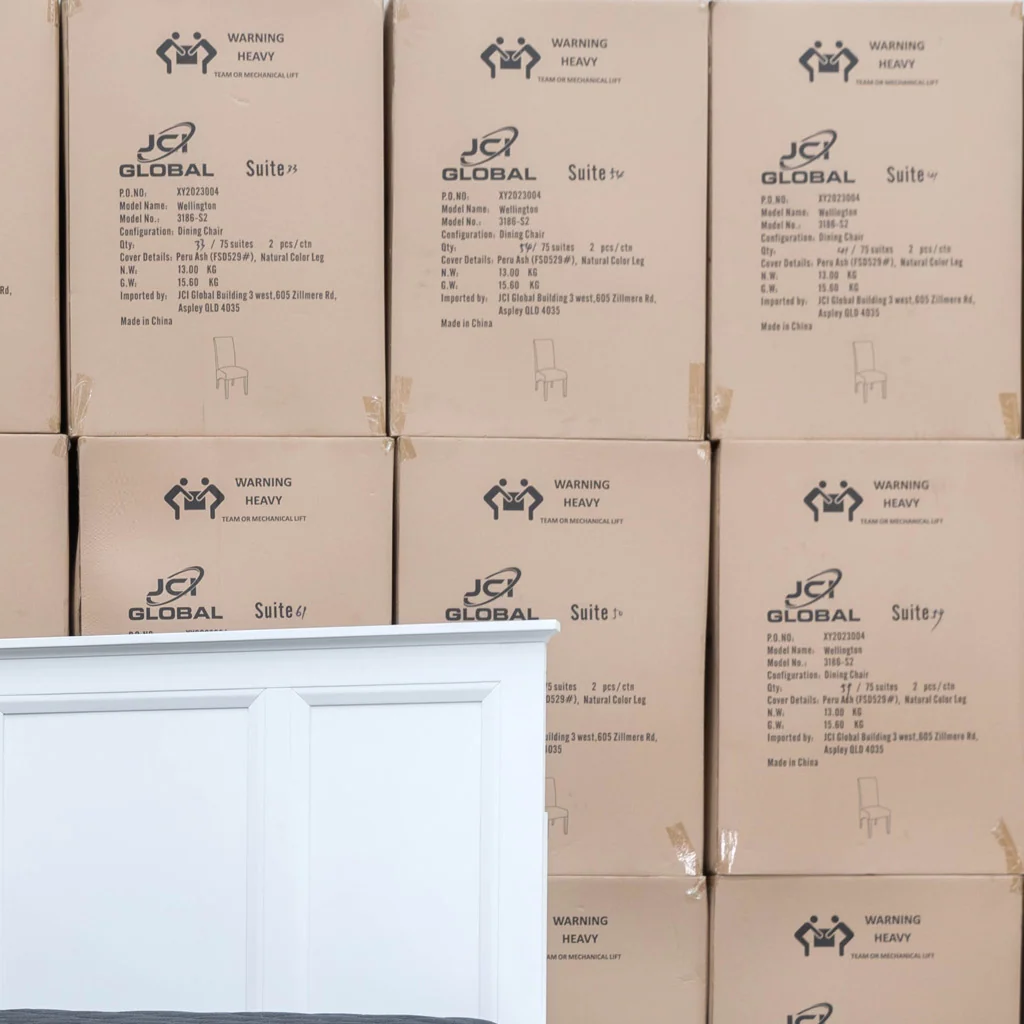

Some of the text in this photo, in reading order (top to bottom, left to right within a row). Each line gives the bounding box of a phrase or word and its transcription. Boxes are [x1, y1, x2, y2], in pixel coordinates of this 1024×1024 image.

[228, 33, 285, 43] WARNING
[552, 38, 608, 48] WARNING
[869, 41, 926, 51] WARNING
[238, 51, 275, 61] HEAVY
[561, 56, 598, 66] HEAVY
[879, 59, 916, 69] HEAVY
[119, 164, 214, 177] GLOBAL
[246, 160, 284, 177] Suite
[568, 164, 606, 181] Suite
[442, 168, 536, 181] GLOBAL
[761, 171, 855, 184] GLOBAL
[887, 166, 924, 183] Suite
[235, 477, 292, 488] WARNING
[554, 479, 610, 489] WARNING
[874, 480, 930, 490] WARNING
[245, 495, 283, 505] HEAVY
[563, 497, 600, 507] HEAVY
[883, 498, 920, 508] HEAVY
[129, 607, 223, 621] GLOBAL
[255, 602, 293, 619] Suite
[446, 608, 539, 621] GLOBAL
[571, 604, 608, 621] Suite
[767, 609, 860, 623] GLOBAL
[891, 605, 929, 621] Suite
[553, 916, 608, 926] WARNING
[864, 914, 921, 925] WARNING
[562, 933, 598, 943] HEAVY
[874, 932, 911, 943] HEAVY
